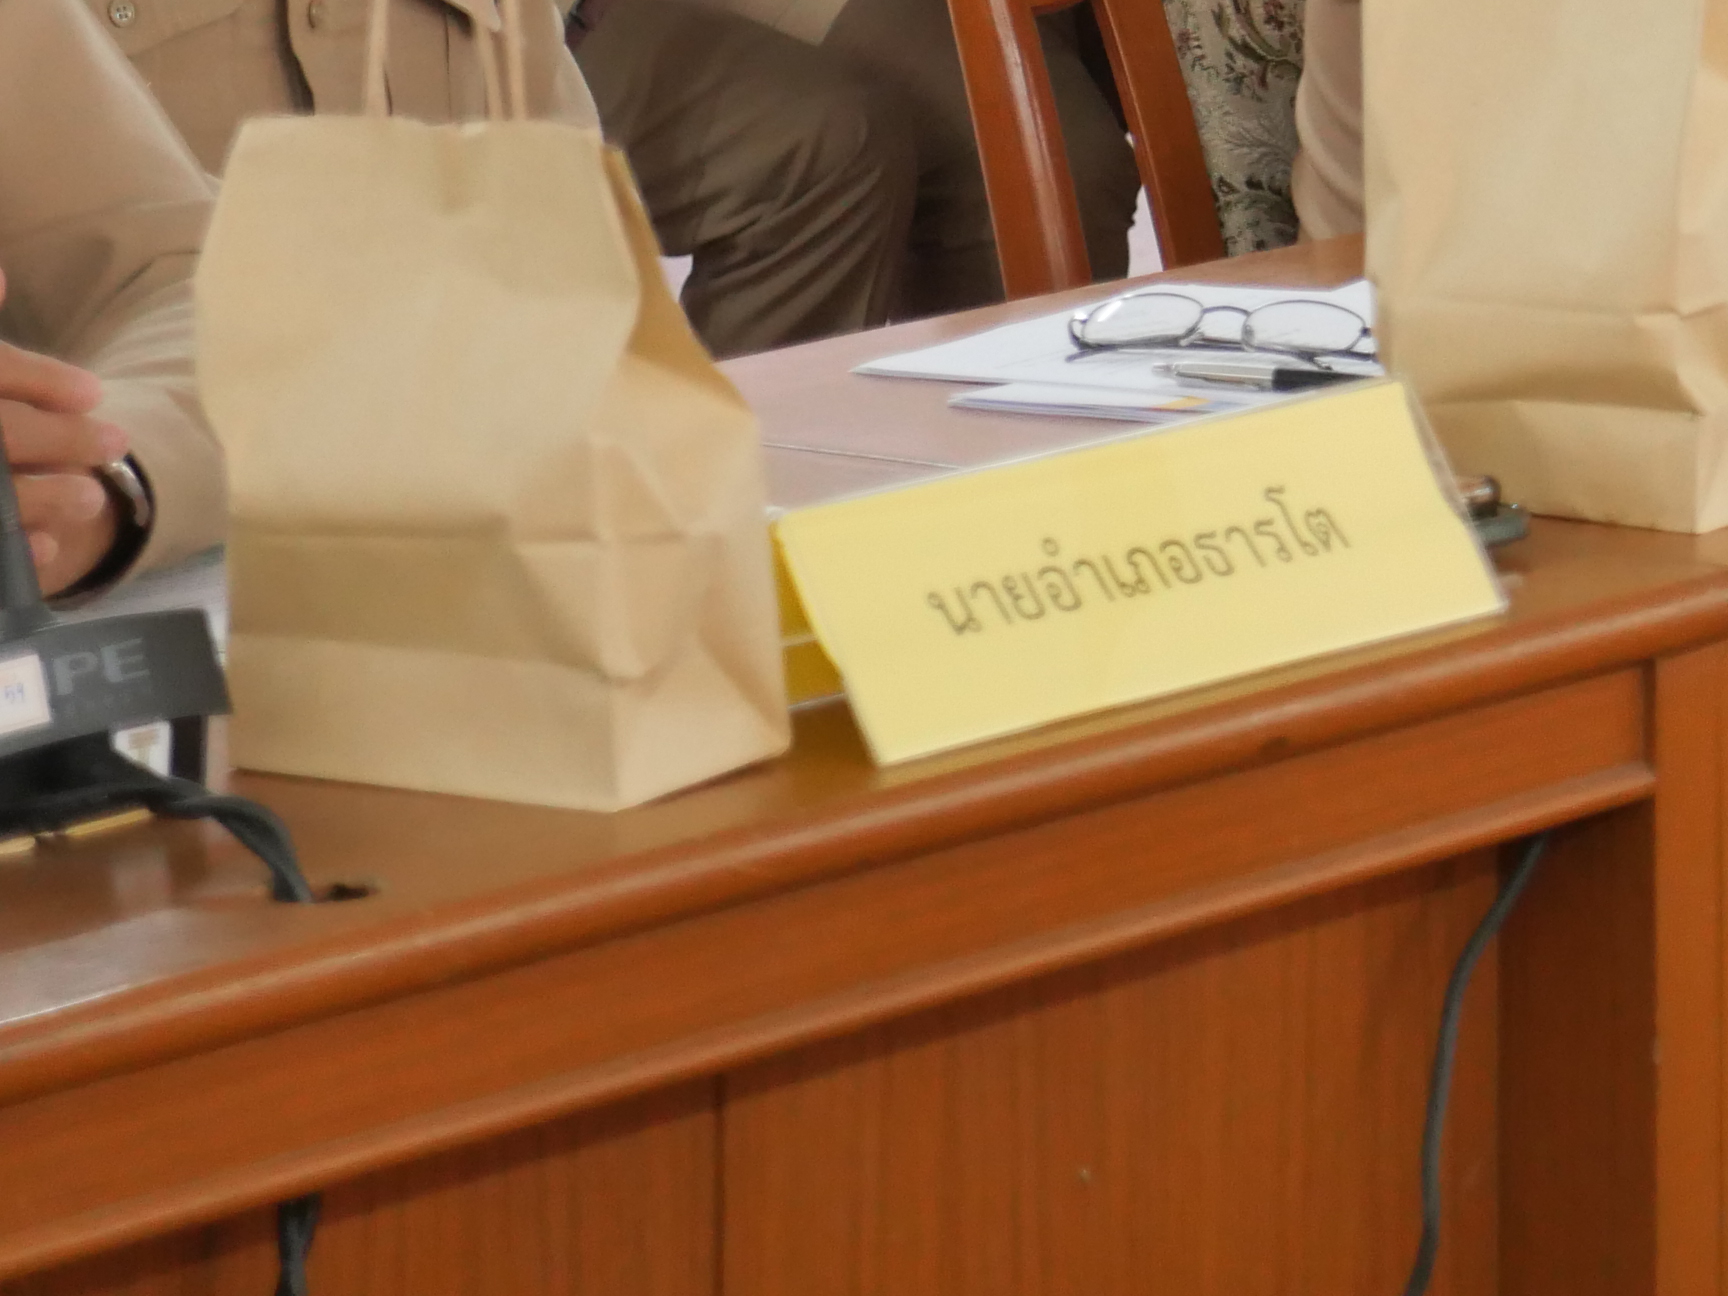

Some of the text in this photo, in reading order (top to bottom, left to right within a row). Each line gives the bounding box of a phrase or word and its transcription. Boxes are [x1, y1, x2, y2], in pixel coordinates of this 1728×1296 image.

[926, 485, 1353, 636] นายอำเภอธารโต
[52, 637, 151, 697] PE
